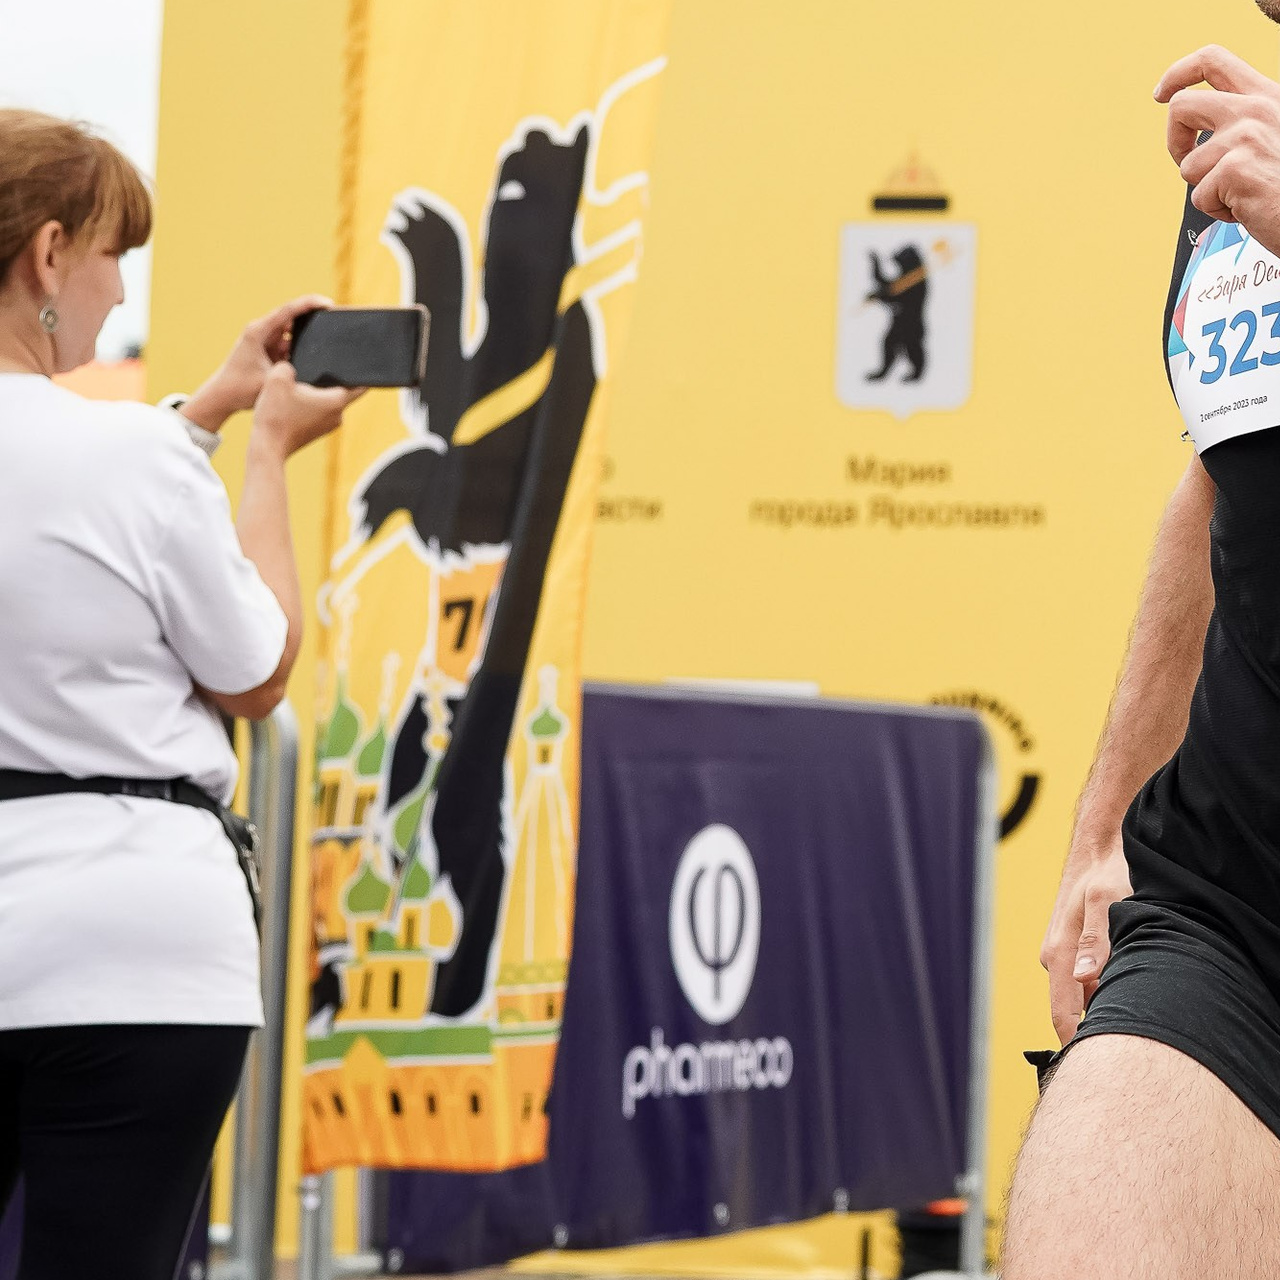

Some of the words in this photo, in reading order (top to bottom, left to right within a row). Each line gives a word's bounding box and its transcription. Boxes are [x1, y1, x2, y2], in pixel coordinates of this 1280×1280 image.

[1233, 398, 1249, 411] 2023
[1251, 394, 1268, 406] года
[621, 1025, 794, 1120] pharmeco
